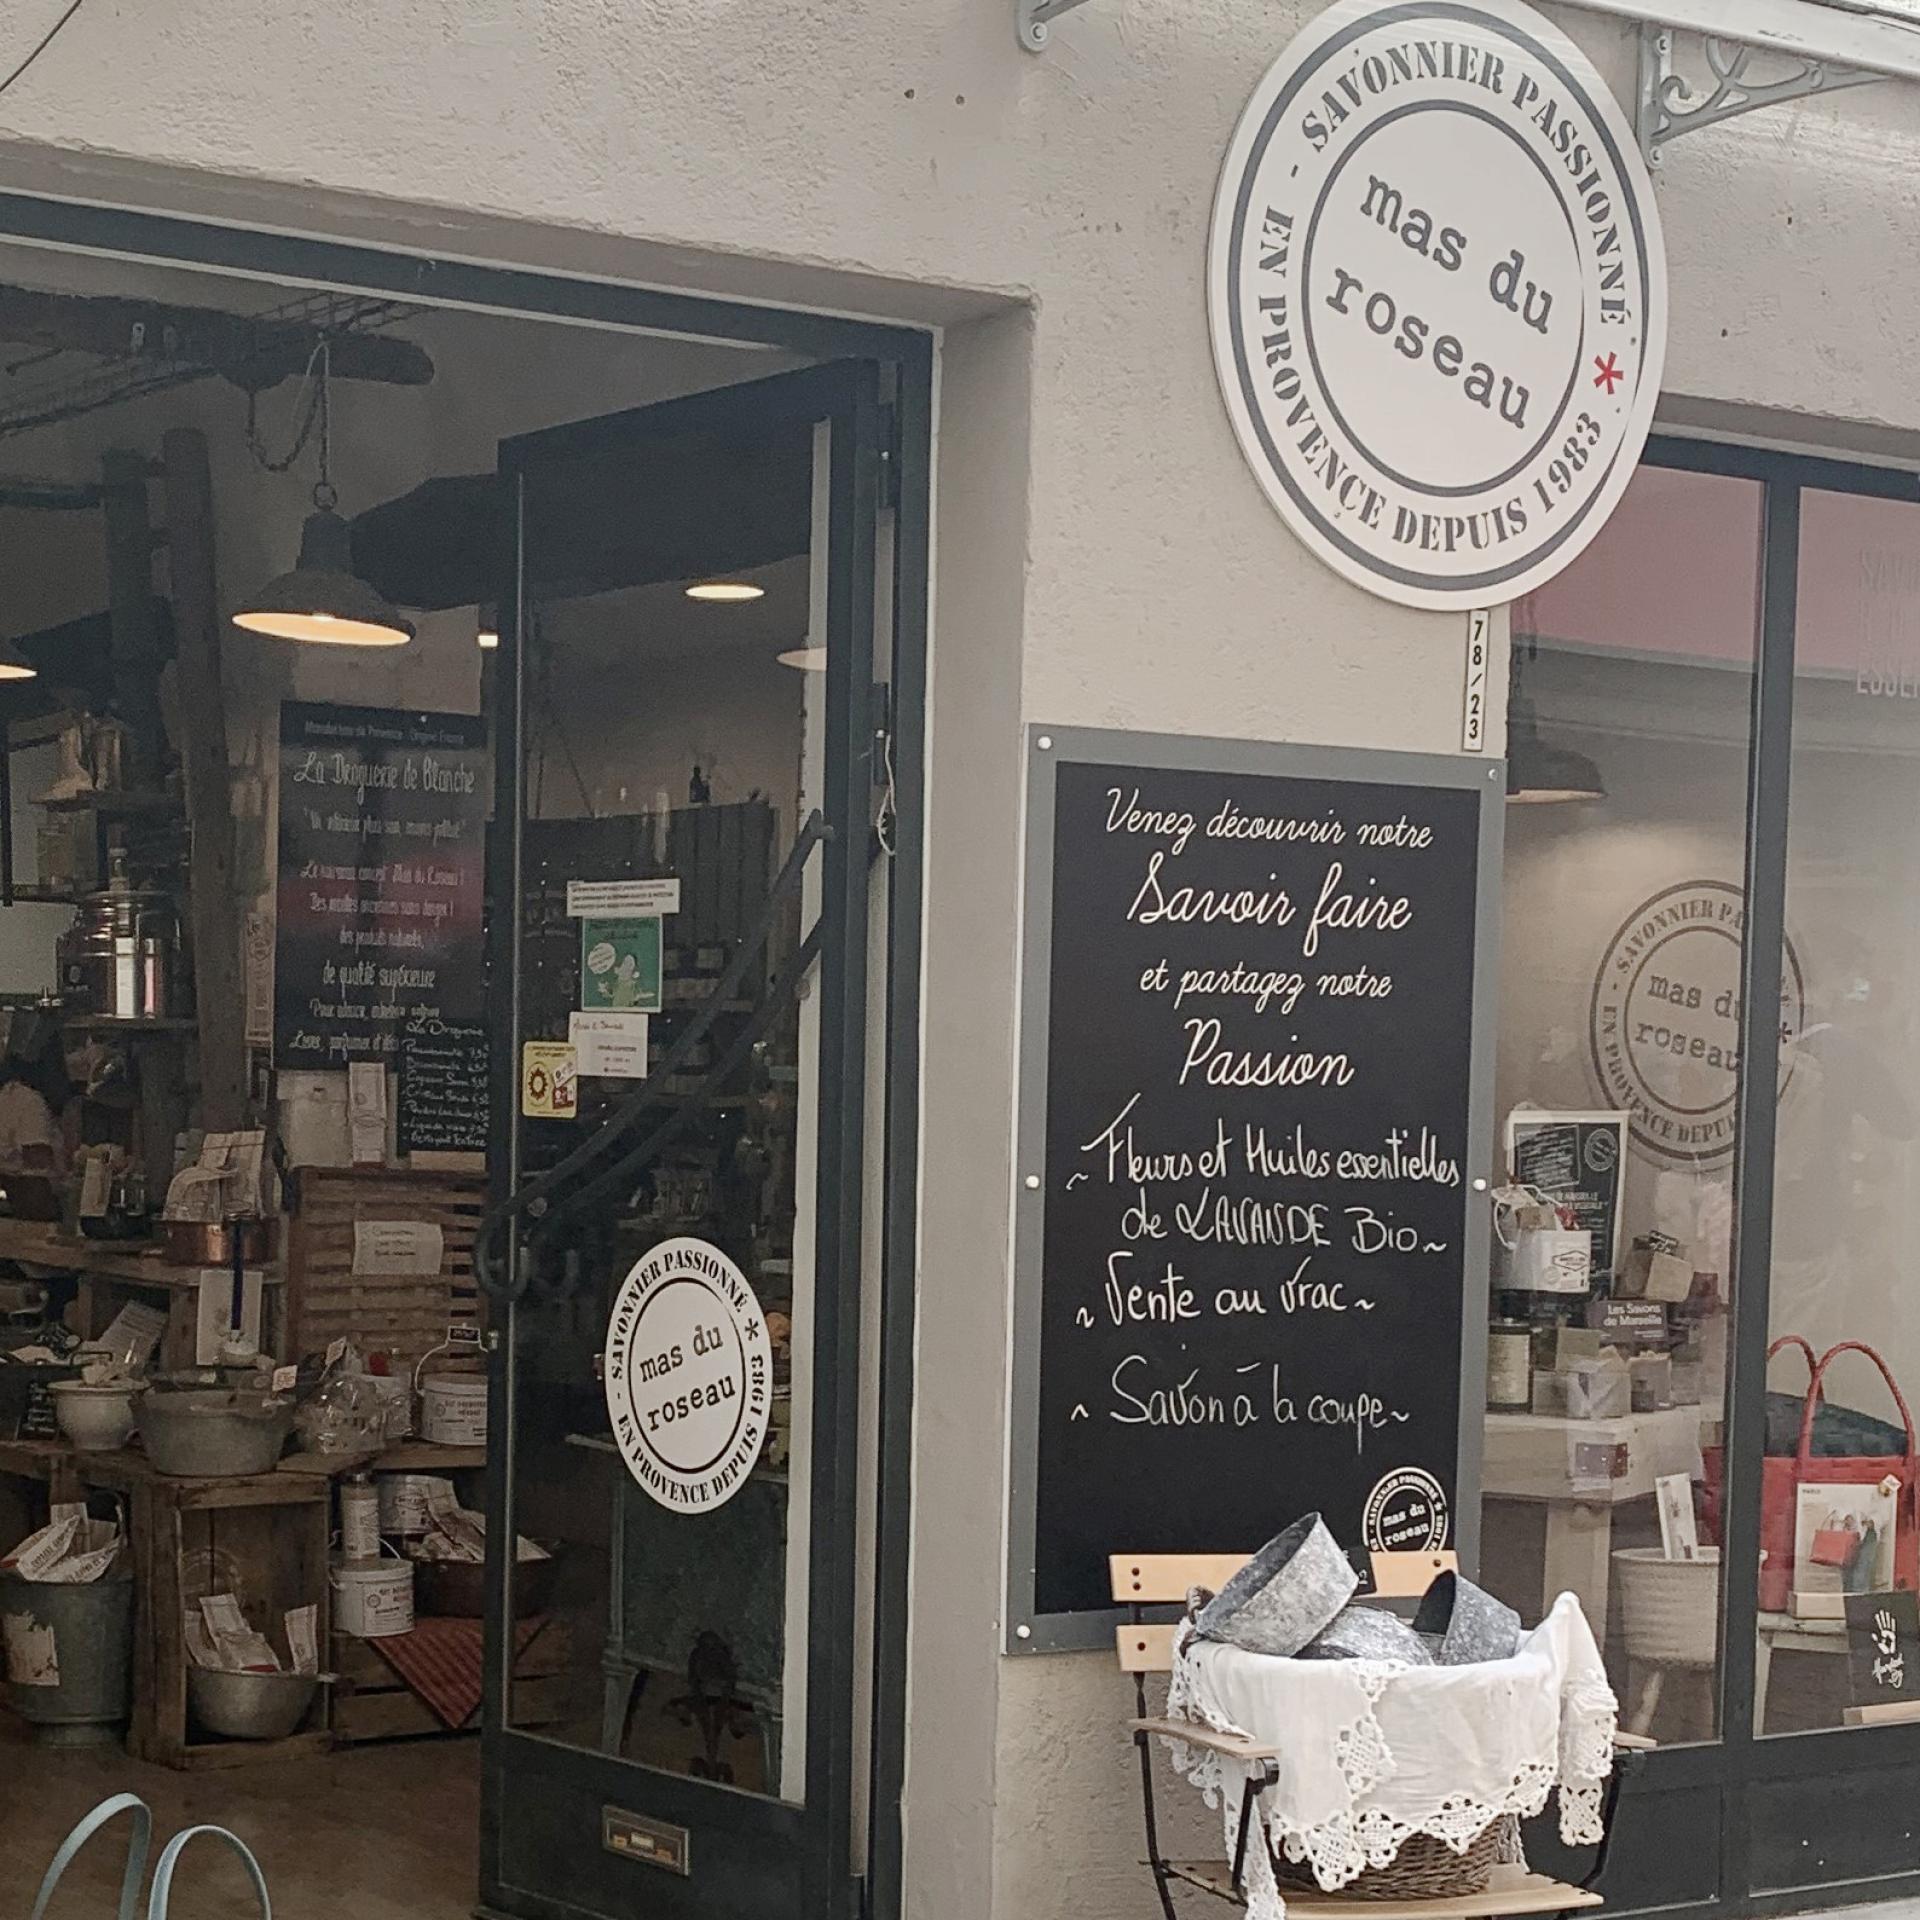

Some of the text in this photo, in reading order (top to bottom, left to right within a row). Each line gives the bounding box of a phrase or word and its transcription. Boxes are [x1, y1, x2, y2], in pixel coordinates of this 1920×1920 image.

[1302, 40, 1632, 325] SAVONNIER PASSIONNÉ
[1359, 174, 1553, 335] mas du
[1258, 204, 1603, 552] EN PROVENCE DEPUIS 1983
[1324, 267, 1531, 430] roseau
[1106, 787, 1434, 855] Venez découvrir notre
[1127, 851, 1414, 958] Savoir faire
[1616, 899, 1713, 974] SAVONNIER
[1139, 959, 1394, 1015] et partagez notre
[1603, 1006, 1617, 1035] EN
[1647, 975, 1740, 1020] mas d
[1178, 1018, 1355, 1086] Passion
[1635, 1022, 1741, 1072] roseau
[1605, 1043, 1671, 1140] PROVENCE
[1081, 1093, 1192, 1185] Fleurs
[1199, 1117, 1233, 1178] et
[1246, 1124, 1331, 1179] Huiles
[1336, 1126, 1461, 1188] essentielles
[1121, 1188, 1168, 1241] de
[1175, 1186, 1332, 1247] LAVANDE
[612, 1250, 748, 1379] SAVONNIER PASSIONNÉ
[1104, 1250, 1201, 1327] Vente
[1214, 1287, 1267, 1315] au
[639, 1323, 724, 1383] mas du
[617, 1354, 765, 1504] EN PROVENCE DEPUIS 1983
[647, 1374, 736, 1432] roseau
[1273, 1364, 1298, 1424] la
[1308, 1392, 1385, 1455] coupe
[1382, 1503, 1426, 1528] mas du
[1384, 1523, 1430, 1546] roseau
